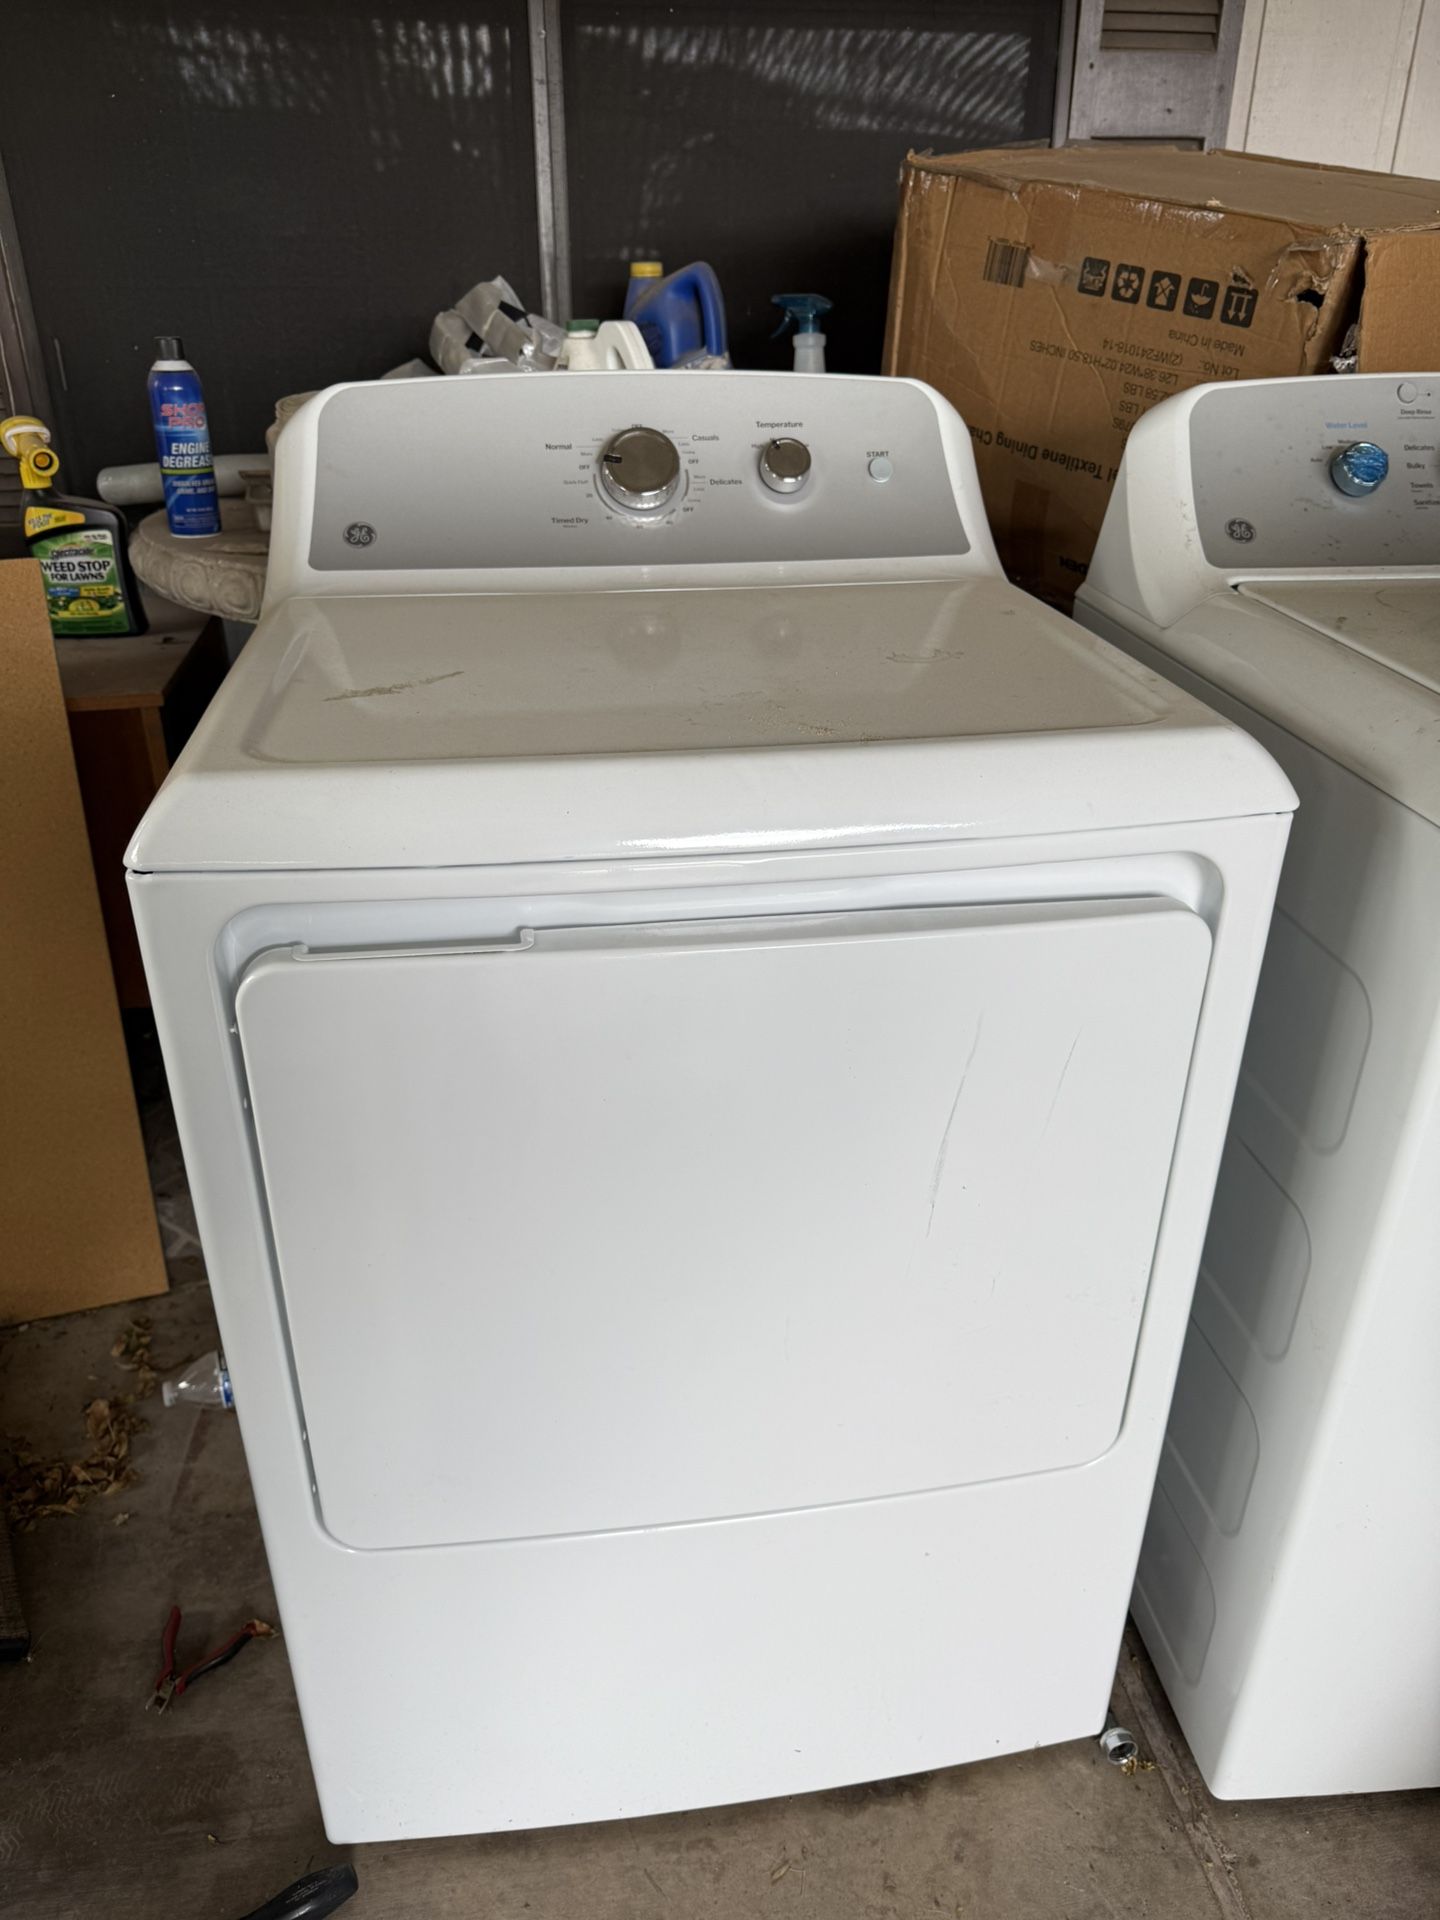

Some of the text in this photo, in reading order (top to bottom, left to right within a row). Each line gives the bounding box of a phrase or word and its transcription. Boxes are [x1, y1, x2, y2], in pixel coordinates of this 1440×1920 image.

[1167, 330, 1198, 347] China
[1029, 340, 1066, 359] INCHES
[1214, 340, 1245, 357] Made
[1221, 365, 1240, 380] Lot
[1123, 382, 1144, 396] LBS
[1118, 400, 1139, 414] LBS
[755, 421, 803, 430] Temperature
[1348, 421, 1368, 429] Level
[692, 434, 720, 442] Casuals
[171, 442, 211, 455] ENGINE
[545, 443, 572, 451] Normal
[996, 431, 1038, 461] Dining
[1041, 448, 1103, 480] Textilene
[1406, 462, 1426, 470] Bulky
[709, 478, 743, 486] Delicates
[575, 517, 588, 526] Dry
[40, 560, 111, 573] WEED STOP
[50, 571, 105, 582] FOR LAWNS
